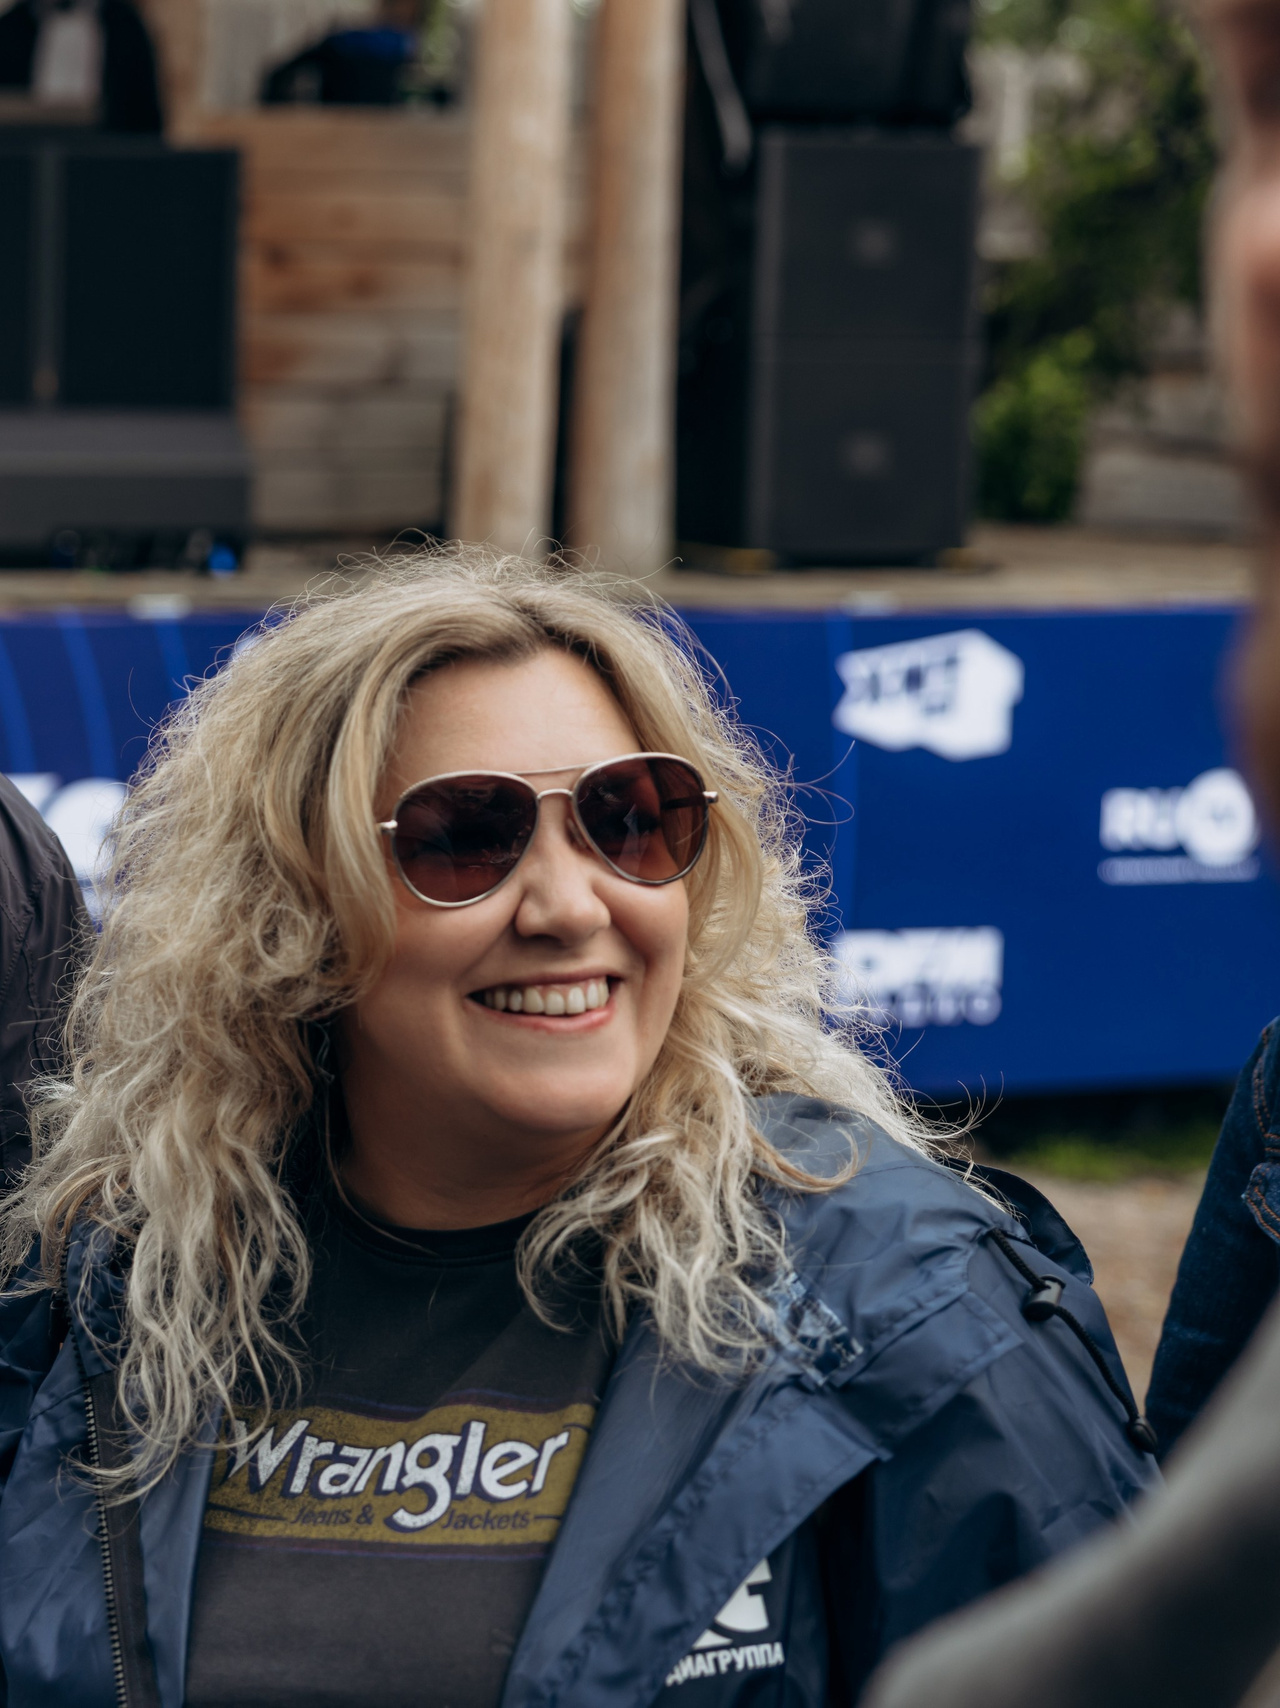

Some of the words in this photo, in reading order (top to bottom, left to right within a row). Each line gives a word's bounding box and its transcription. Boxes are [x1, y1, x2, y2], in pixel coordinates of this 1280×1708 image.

[227, 1419, 570, 1531] Wrangler
[291, 1505, 352, 1525] Jeans
[356, 1503, 374, 1525] &
[442, 1509, 530, 1531] Jackets
